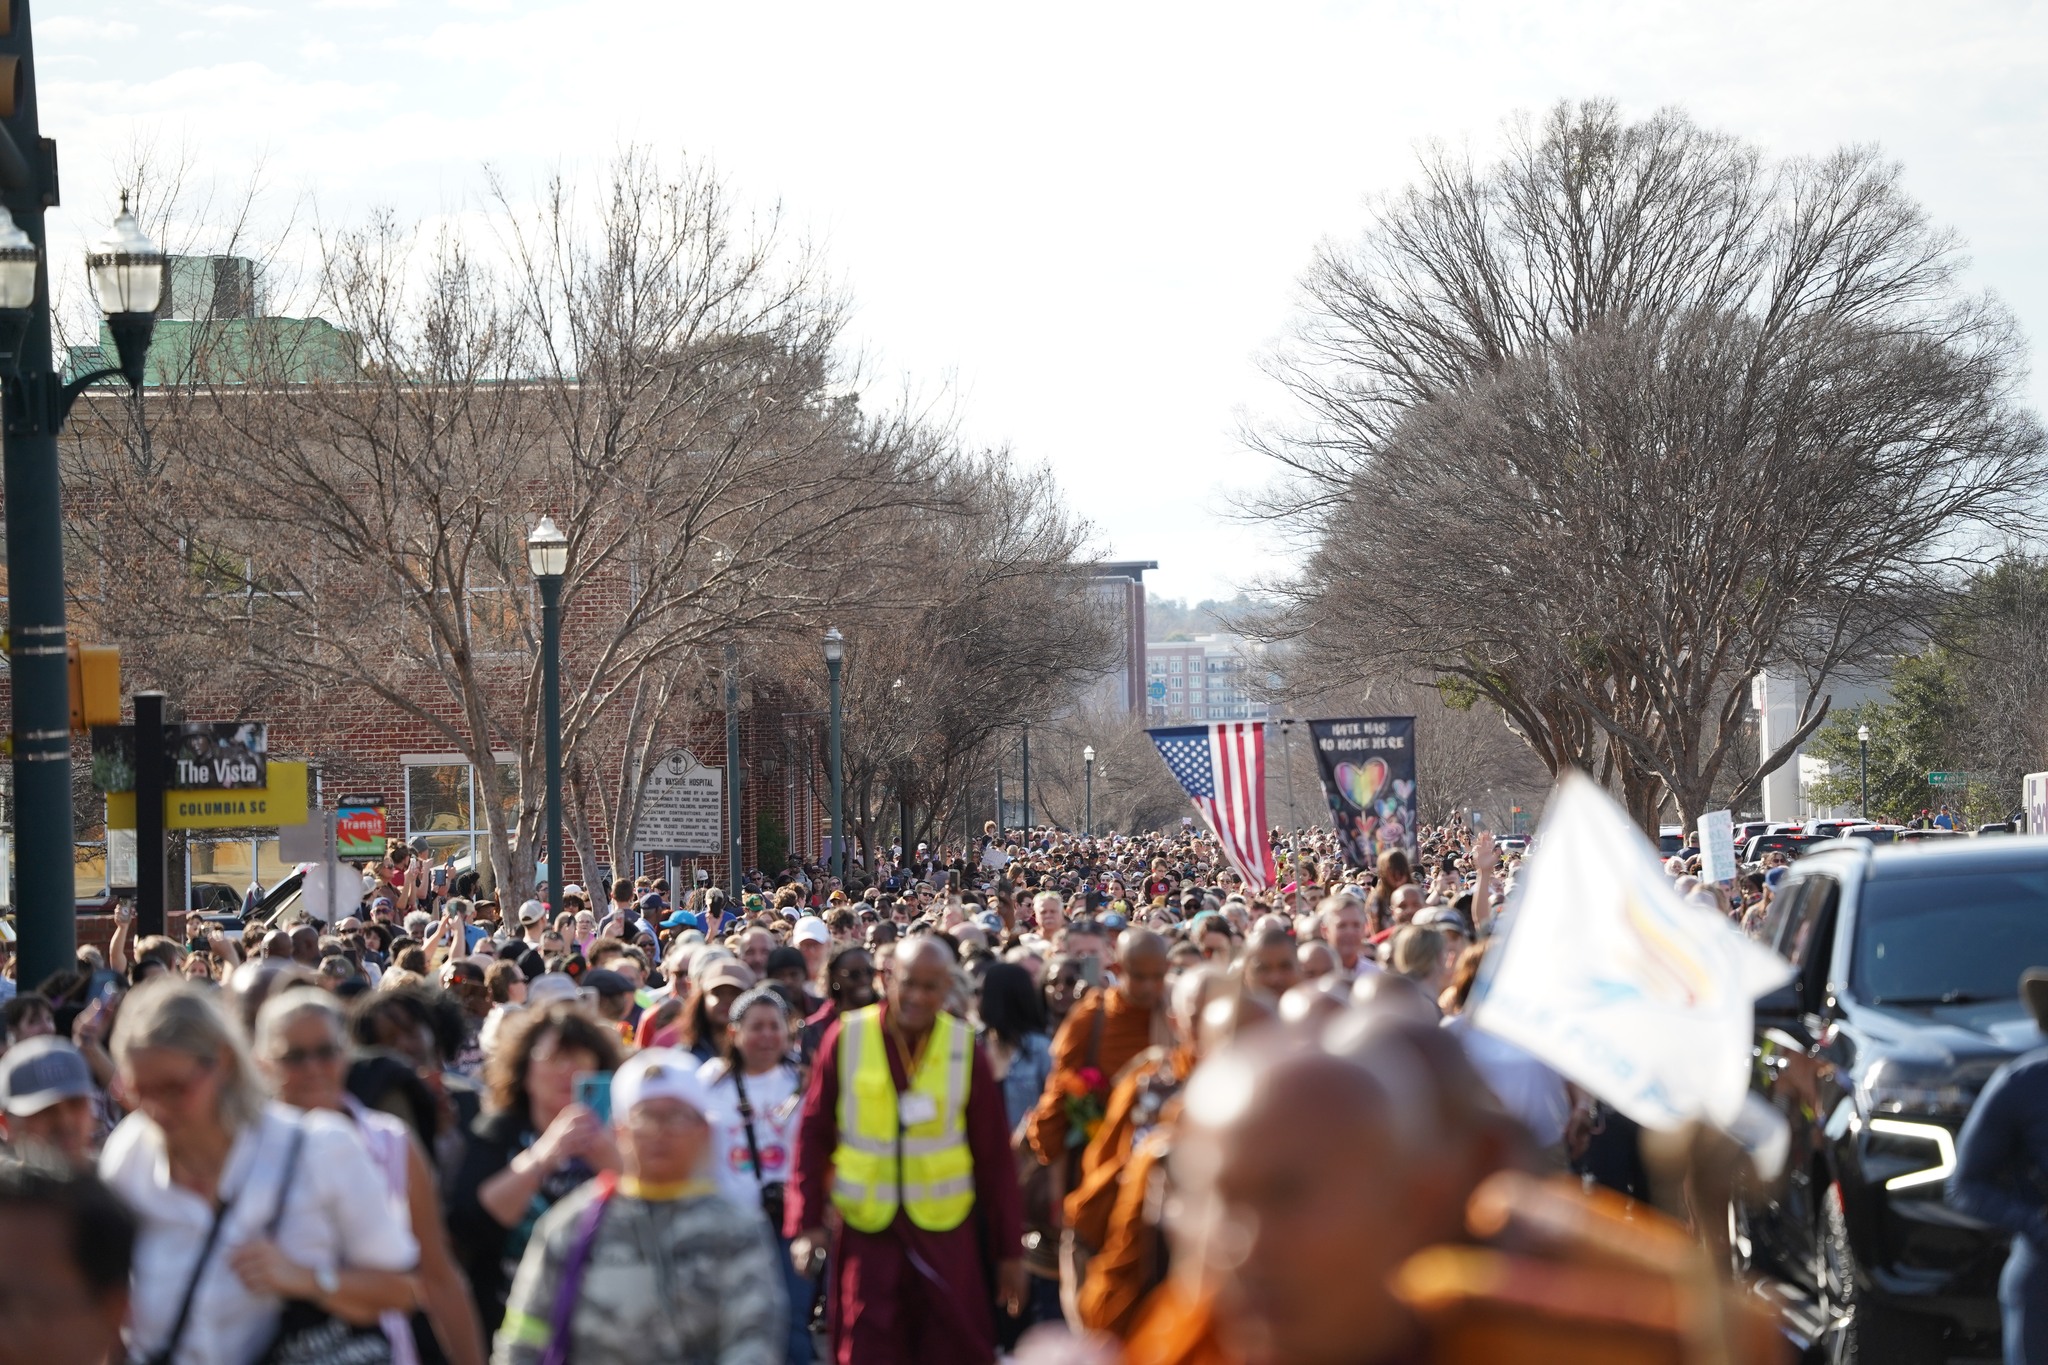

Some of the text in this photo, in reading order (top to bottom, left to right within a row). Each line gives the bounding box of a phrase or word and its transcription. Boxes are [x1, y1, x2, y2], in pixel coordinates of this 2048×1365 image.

[1332, 722, 1388, 736] HATE HAS
[1319, 736, 1405, 751] NO HOME HERE
[177, 758, 257, 784] The Vista
[655, 777, 662, 786] OF
[689, 778, 714, 787] HOSPITAL
[179, 801, 266, 816] COLUMBIA SC
[341, 818, 382, 830] Transit
